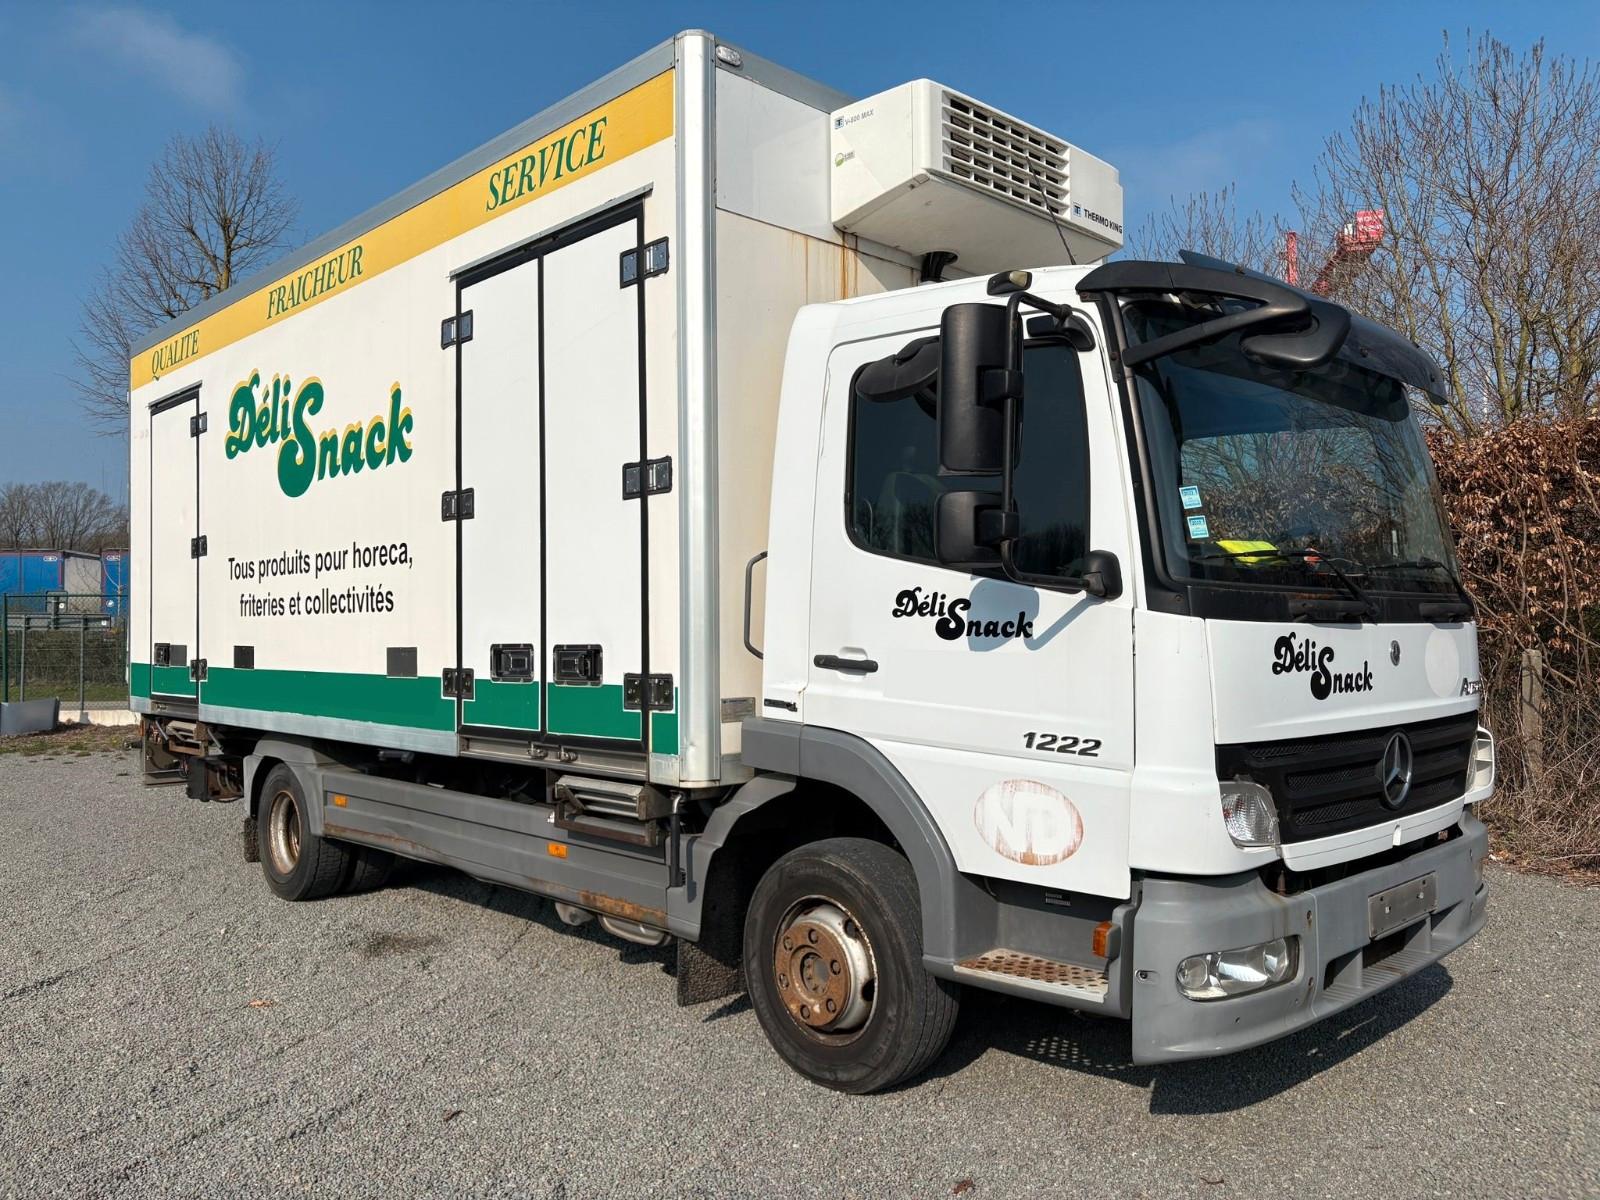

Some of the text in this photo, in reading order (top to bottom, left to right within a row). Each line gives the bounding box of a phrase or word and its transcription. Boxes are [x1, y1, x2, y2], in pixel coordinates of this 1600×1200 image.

[486, 116, 607, 212] SERVICE
[1084, 208, 1122, 234] THERMO KING
[266, 245, 364, 320] FRAICHEUR
[152, 329, 200, 381] QUALITE
[277, 376, 414, 498] Snack
[228, 541, 413, 584] Tous produits pour horeca,
[240, 583, 394, 617] friteries et collectivités
[892, 586, 1034, 640] Déli Snack
[1310, 647, 1373, 700] Snack
[1023, 731, 1102, 757] 1222
